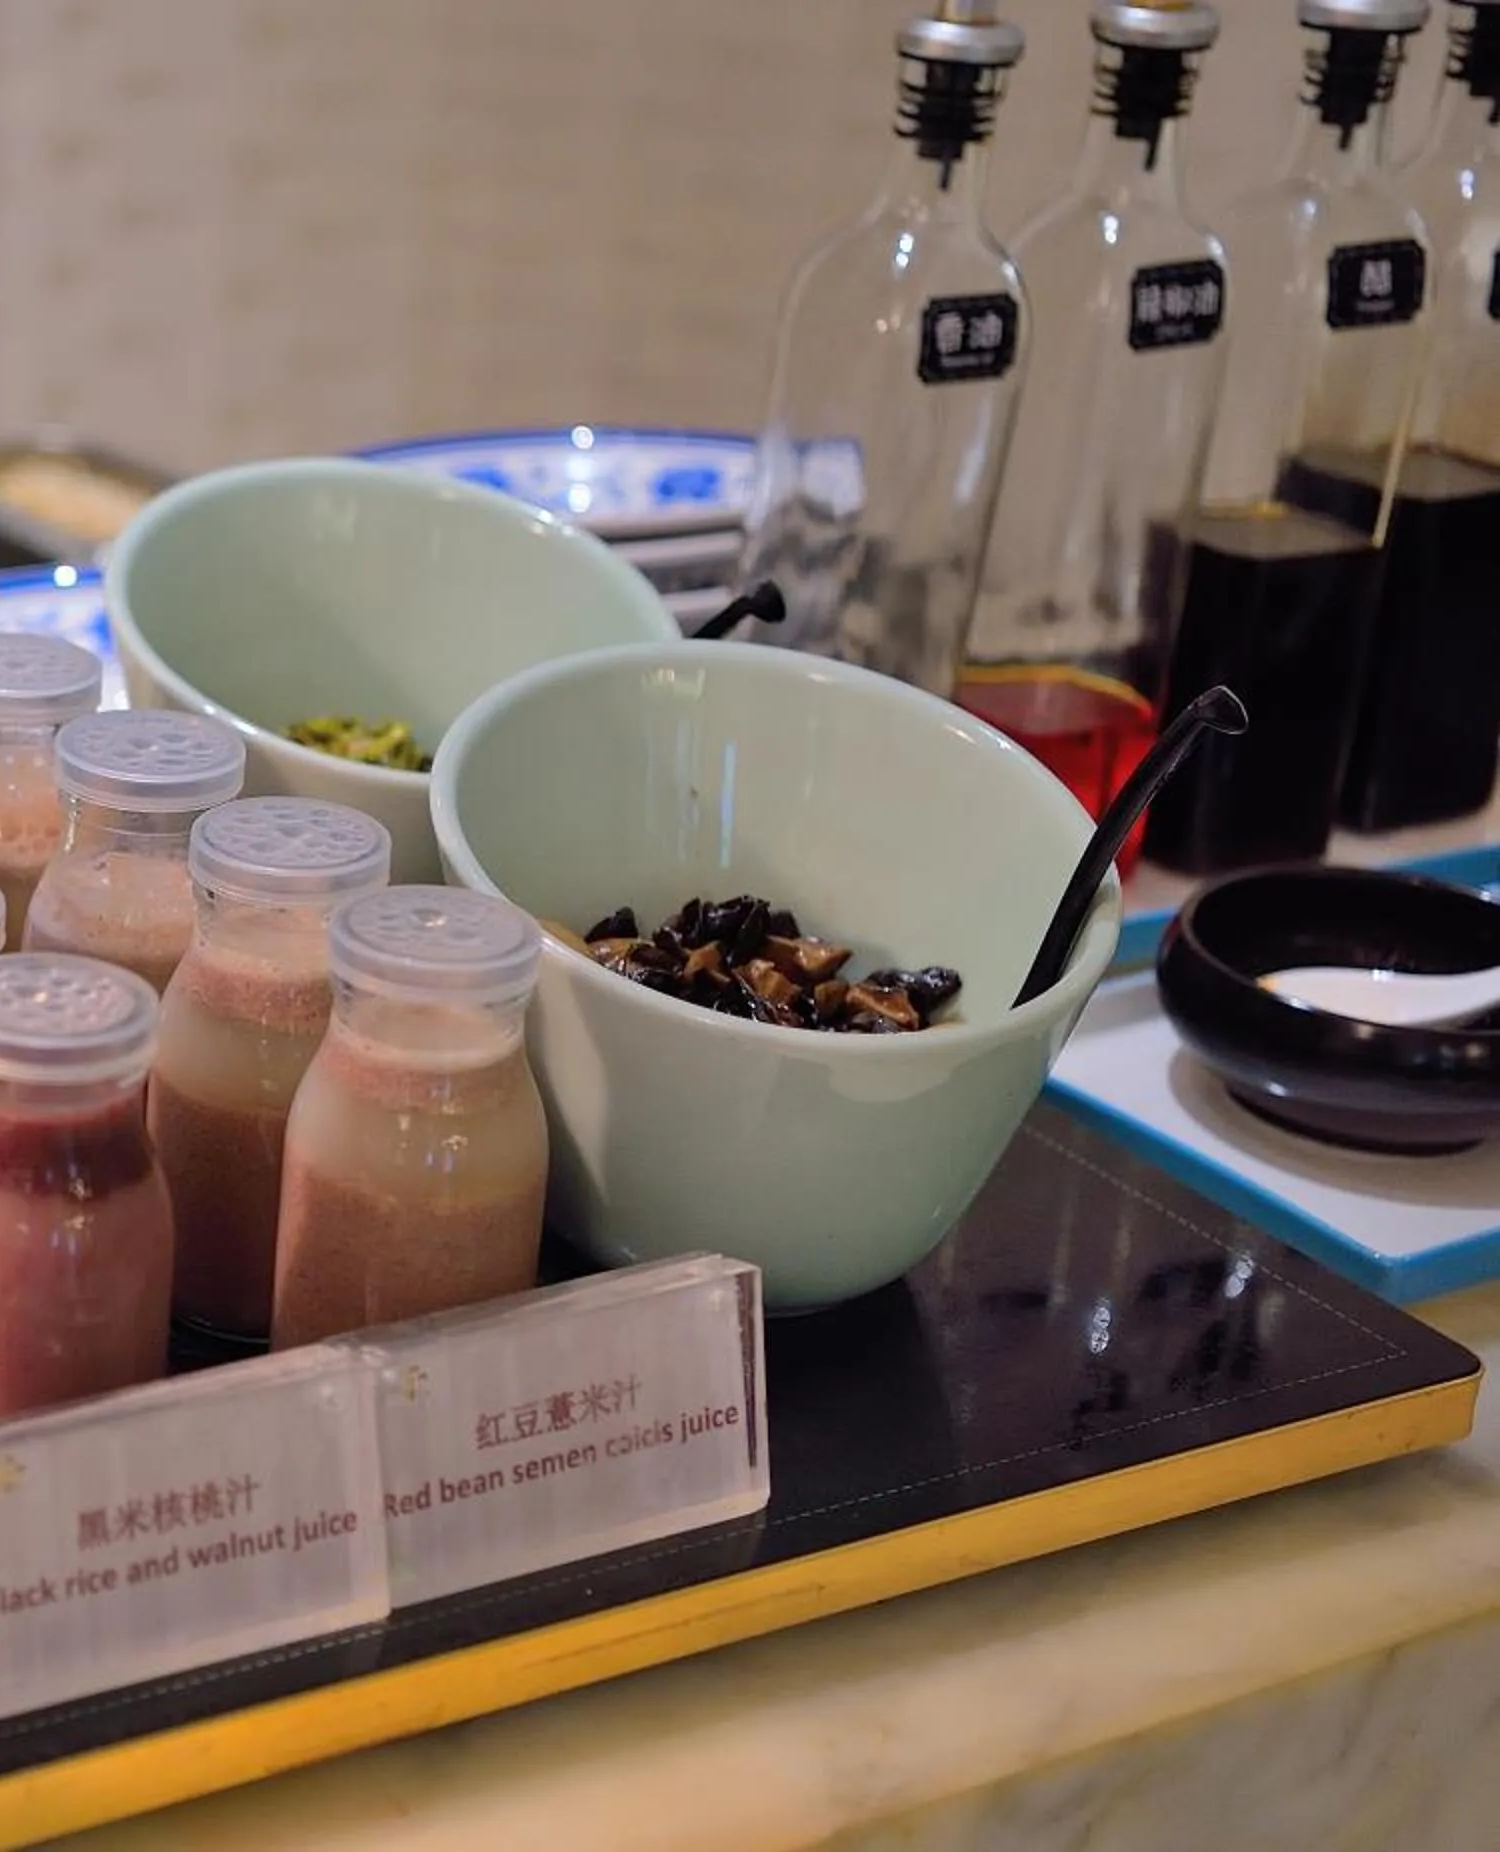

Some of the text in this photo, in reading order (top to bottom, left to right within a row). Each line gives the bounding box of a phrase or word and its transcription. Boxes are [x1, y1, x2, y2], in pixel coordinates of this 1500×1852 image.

[476, 1373, 642, 1451] 红豆薏米汁
[383, 1481, 431, 1519] Red
[439, 1470, 505, 1503] bean
[511, 1444, 598, 1485] semen
[680, 1404, 740, 1444] juice
[64, 1566, 118, 1599] rice
[126, 1546, 180, 1586] and
[187, 1526, 286, 1569] walnut
[293, 1509, 359, 1551] juice
[78, 1473, 259, 1551] 黑米核桃汁
